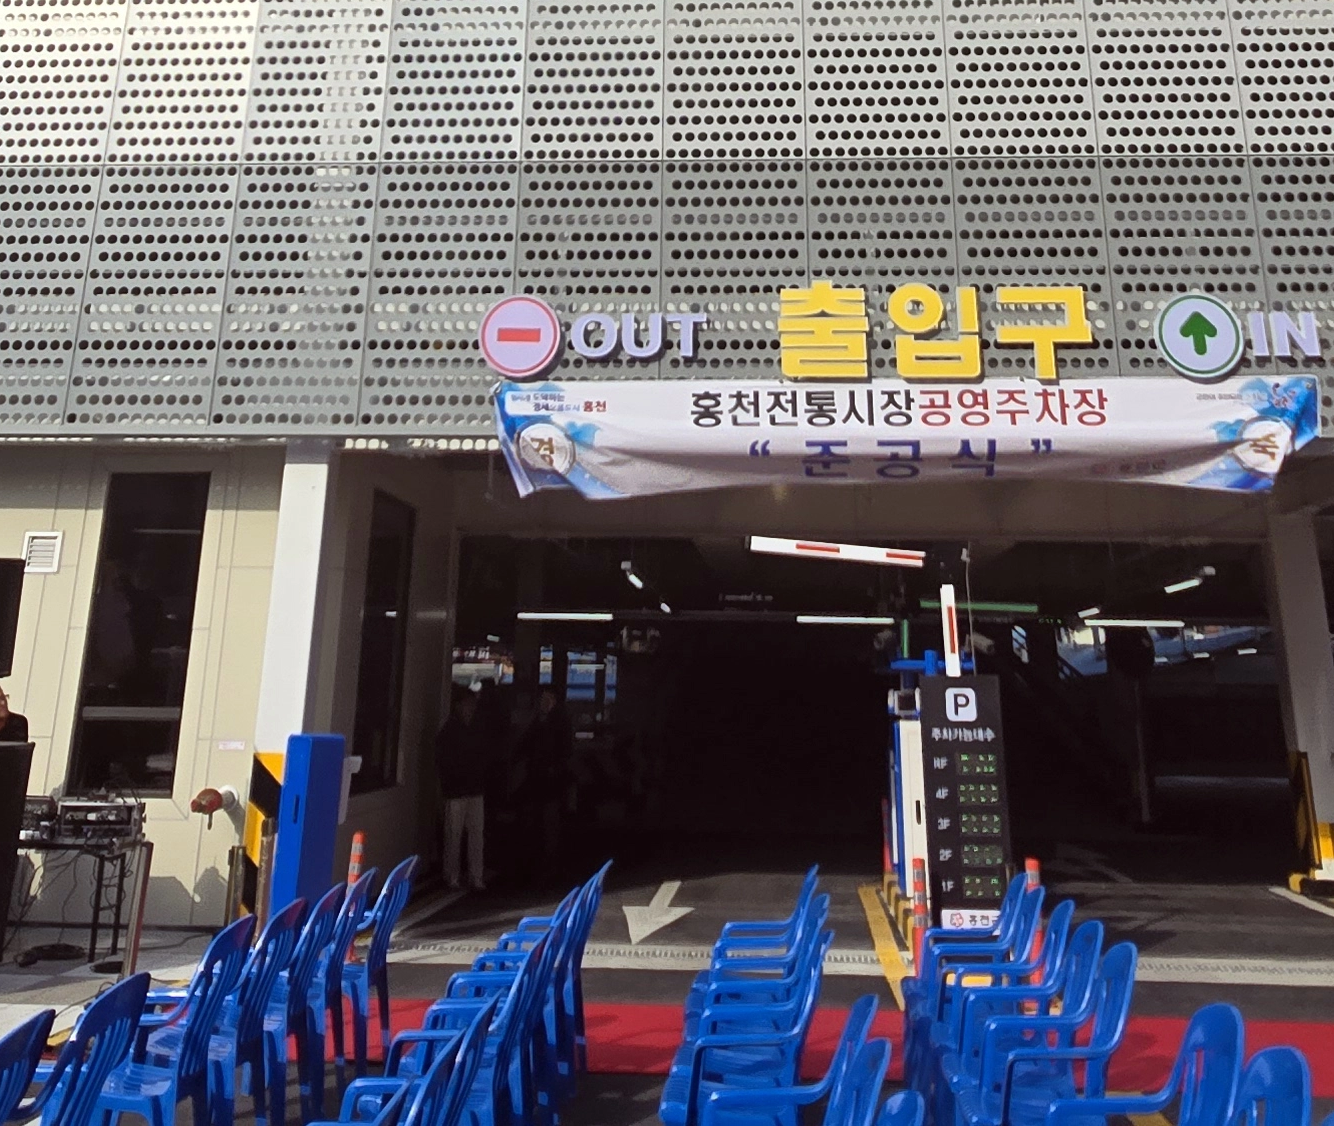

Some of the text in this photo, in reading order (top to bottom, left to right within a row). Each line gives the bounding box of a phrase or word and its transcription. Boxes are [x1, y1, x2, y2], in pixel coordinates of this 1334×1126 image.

[570, 312, 708, 362] OUT
[777, 280, 1094, 380] 출입구
[1251, 312, 1323, 359] IN
[583, 401, 607, 412] 홍천
[690, 388, 1108, 427] 홍천전통시장공영주차장
[953, 693, 970, 717] P
[931, 727, 996, 742] 주차가능대수
[936, 786, 949, 799] 4F
[937, 817, 951, 830] 3F
[939, 848, 953, 862] 2F
[941, 879, 954, 892] 1F
